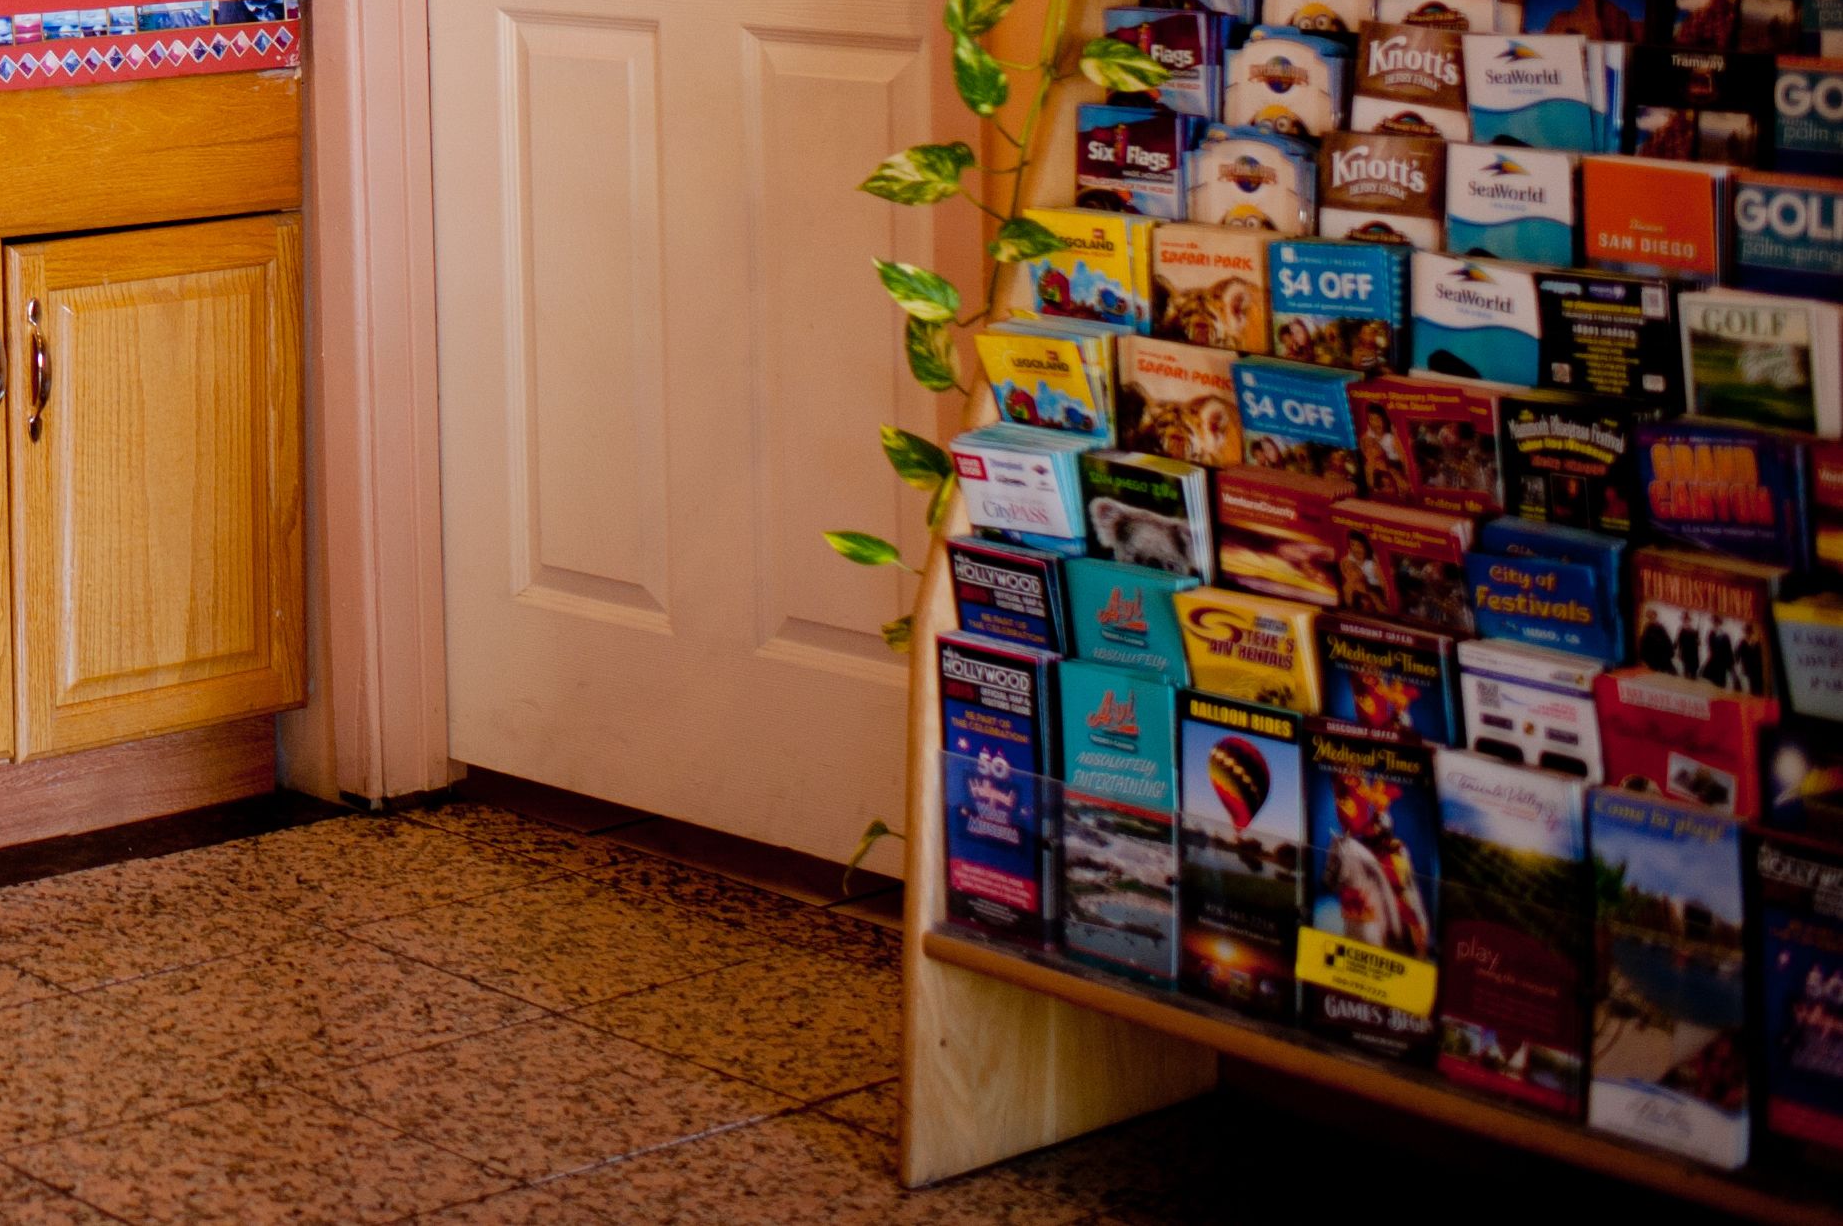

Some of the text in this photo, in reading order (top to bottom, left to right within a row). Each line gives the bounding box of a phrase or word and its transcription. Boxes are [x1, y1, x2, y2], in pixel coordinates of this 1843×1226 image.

[1150, 43, 1195, 68] Flags
[1368, 35, 1460, 86] Knott's
[1670, 54, 1726, 72] Tramway
[1485, 69, 1562, 86] SeaWorld
[1086, 139, 1172, 172] Six Flags
[1331, 144, 1428, 194] Knott's
[1468, 180, 1546, 204] SeaWorld
[1160, 250, 1254, 271] SAFARI PARK
[1597, 232, 1696, 259] SAN DIEGO
[1277, 267, 1375, 301] $4 OFF
[1434, 283, 1515, 315] SeaWorld
[1700, 308, 1786, 336] GOLF
[1012, 357, 1070, 373] LEGOLAND
[1136, 358, 1233, 391] SAFARI PARK
[1241, 390, 1336, 430] $4 OFF
[955, 561, 1042, 595] HOLLYWOOD
[1488, 564, 1558, 591] City of
[1474, 585, 1593, 625] Festivals
[1238, 645, 1295, 671] RENTALS
[1326, 634, 1439, 678] Medieval Times
[942, 657, 1031, 692] HOLLYWOOD
[1188, 698, 1293, 740] BALLOON RIDES
[977, 752, 1011, 779] 50
[1311, 735, 1422, 774] Medieval Times
[965, 815, 1023, 847] MUSEUM
[1345, 948, 1406, 976] CERTIFIED
[1456, 935, 1501, 972] play
[1324, 993, 1383, 1024] GAMES
